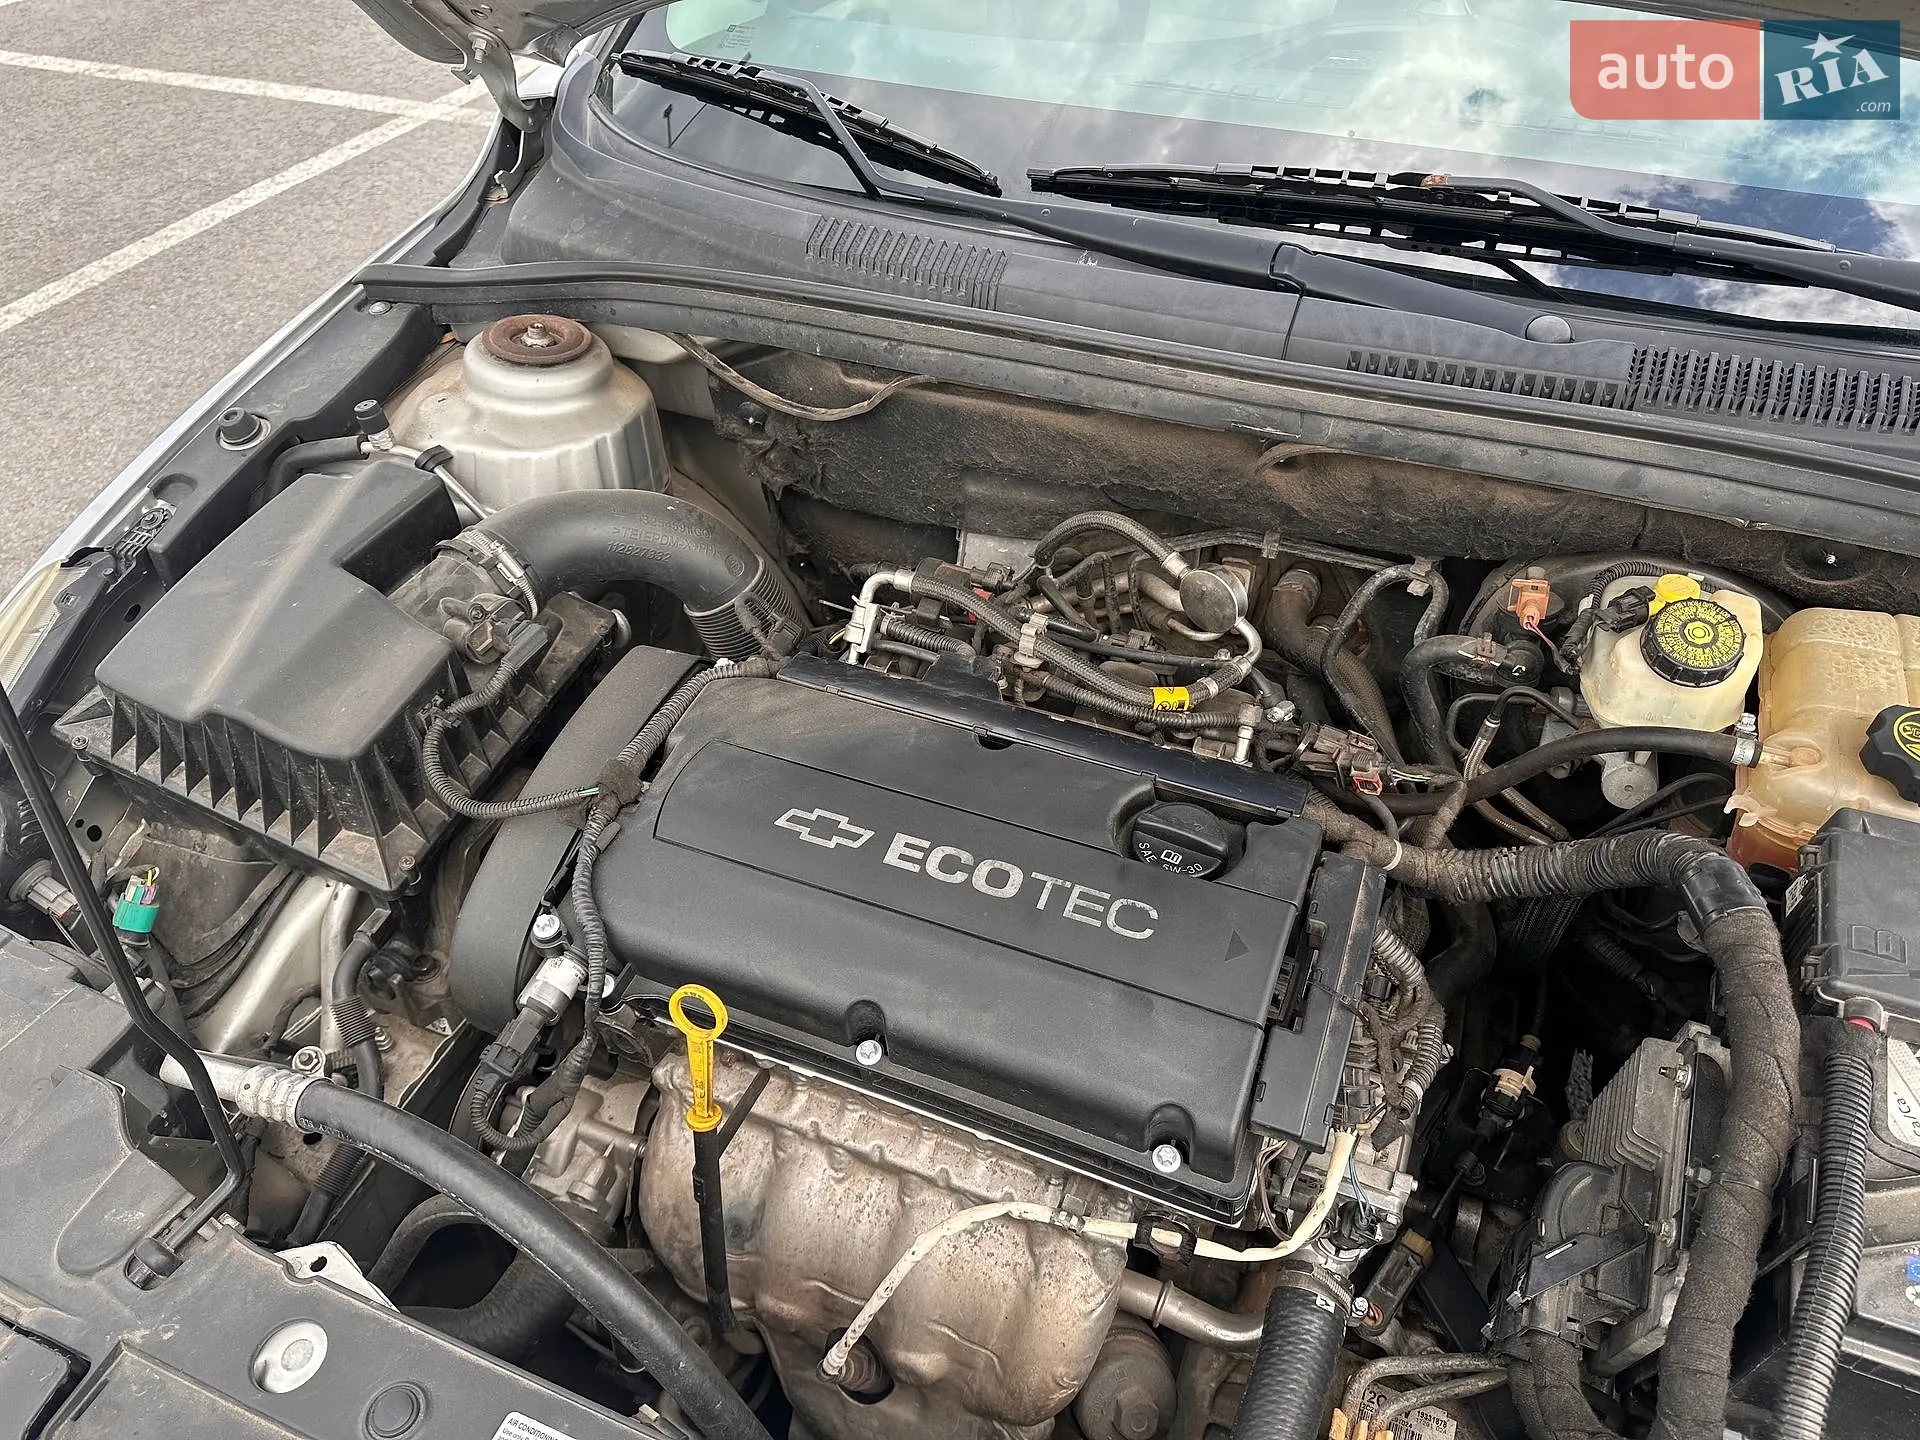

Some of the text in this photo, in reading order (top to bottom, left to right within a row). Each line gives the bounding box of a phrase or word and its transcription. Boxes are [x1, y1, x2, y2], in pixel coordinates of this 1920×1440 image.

[1138, 842, 1158, 863] SAE
[882, 832, 1159, 940] ECOTEC
[507, 1418, 558, 1440] AIR CONDITIONIN
